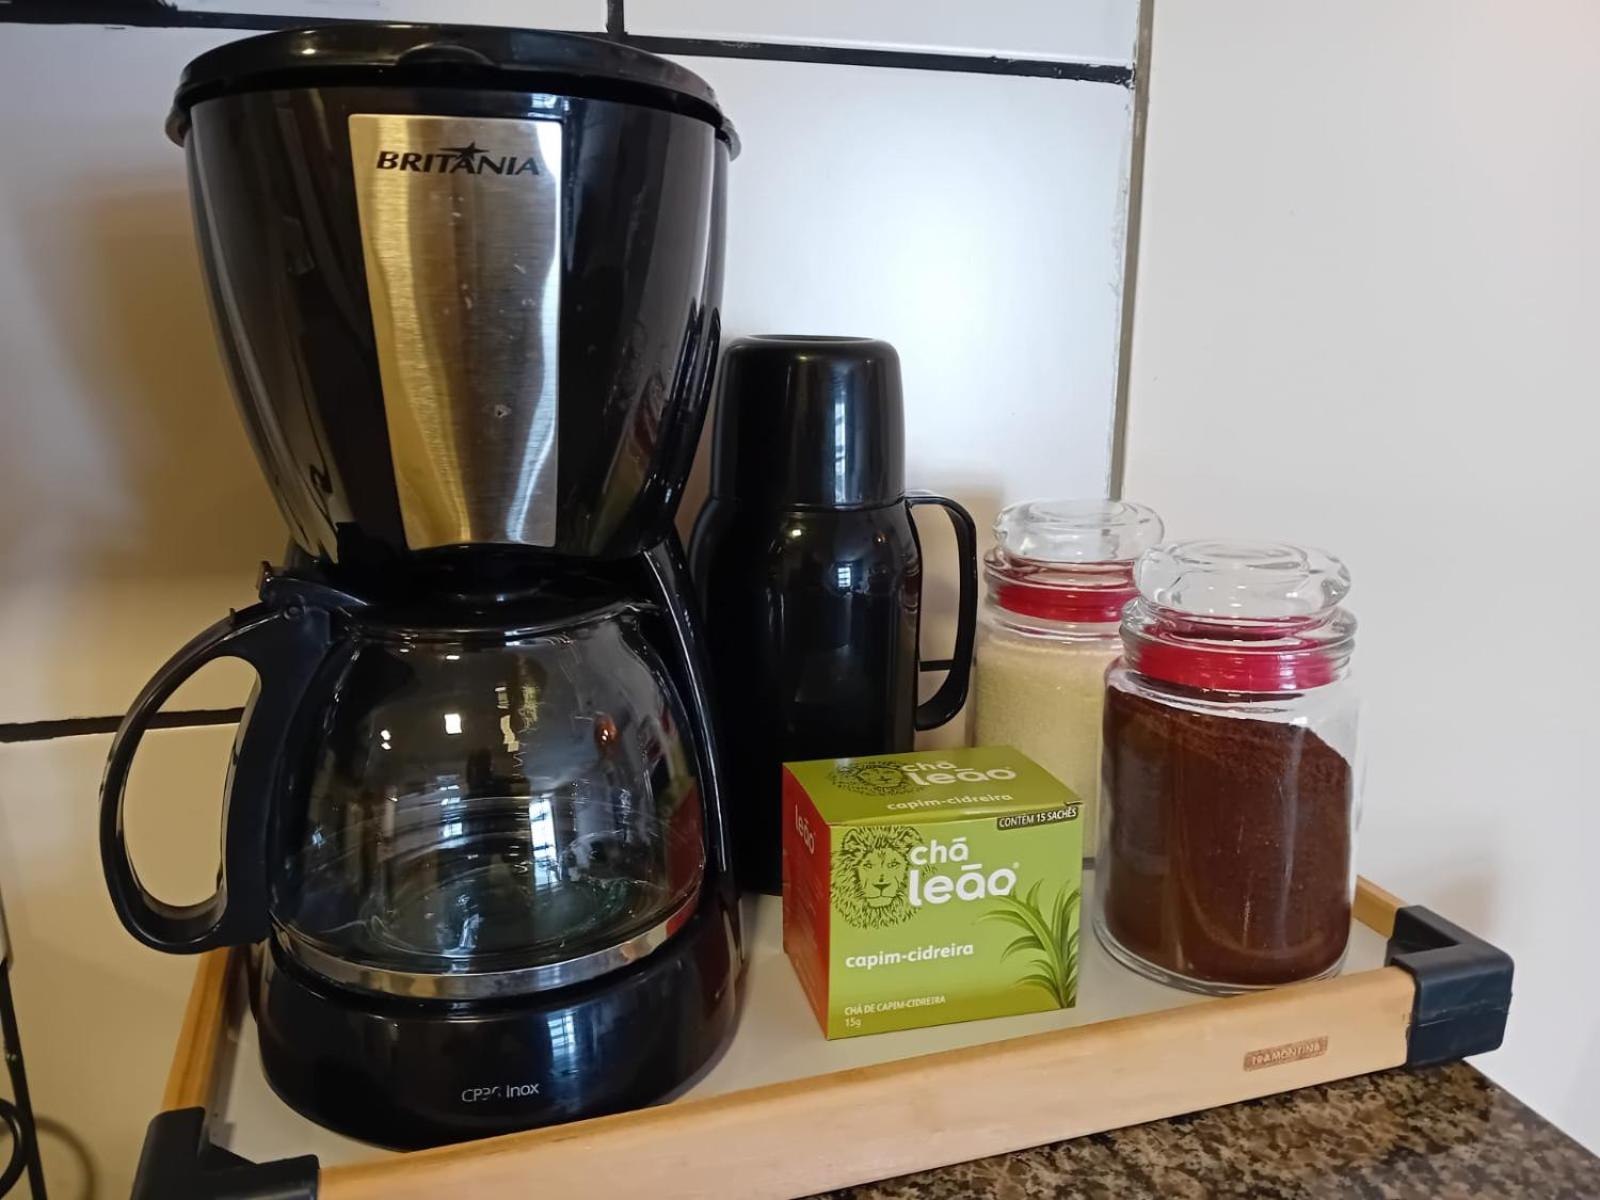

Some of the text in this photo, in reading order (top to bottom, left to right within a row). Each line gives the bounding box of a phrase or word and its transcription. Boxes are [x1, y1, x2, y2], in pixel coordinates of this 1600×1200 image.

[886, 794, 1013, 811] capim-cidreira
[1037, 813, 1046, 823] 15
[845, 942, 975, 970] capim-cidreira
[844, 995, 946, 1016] CHÁ DE CAPIM-CIDREIRA
[845, 1017, 862, 1029] 15g
